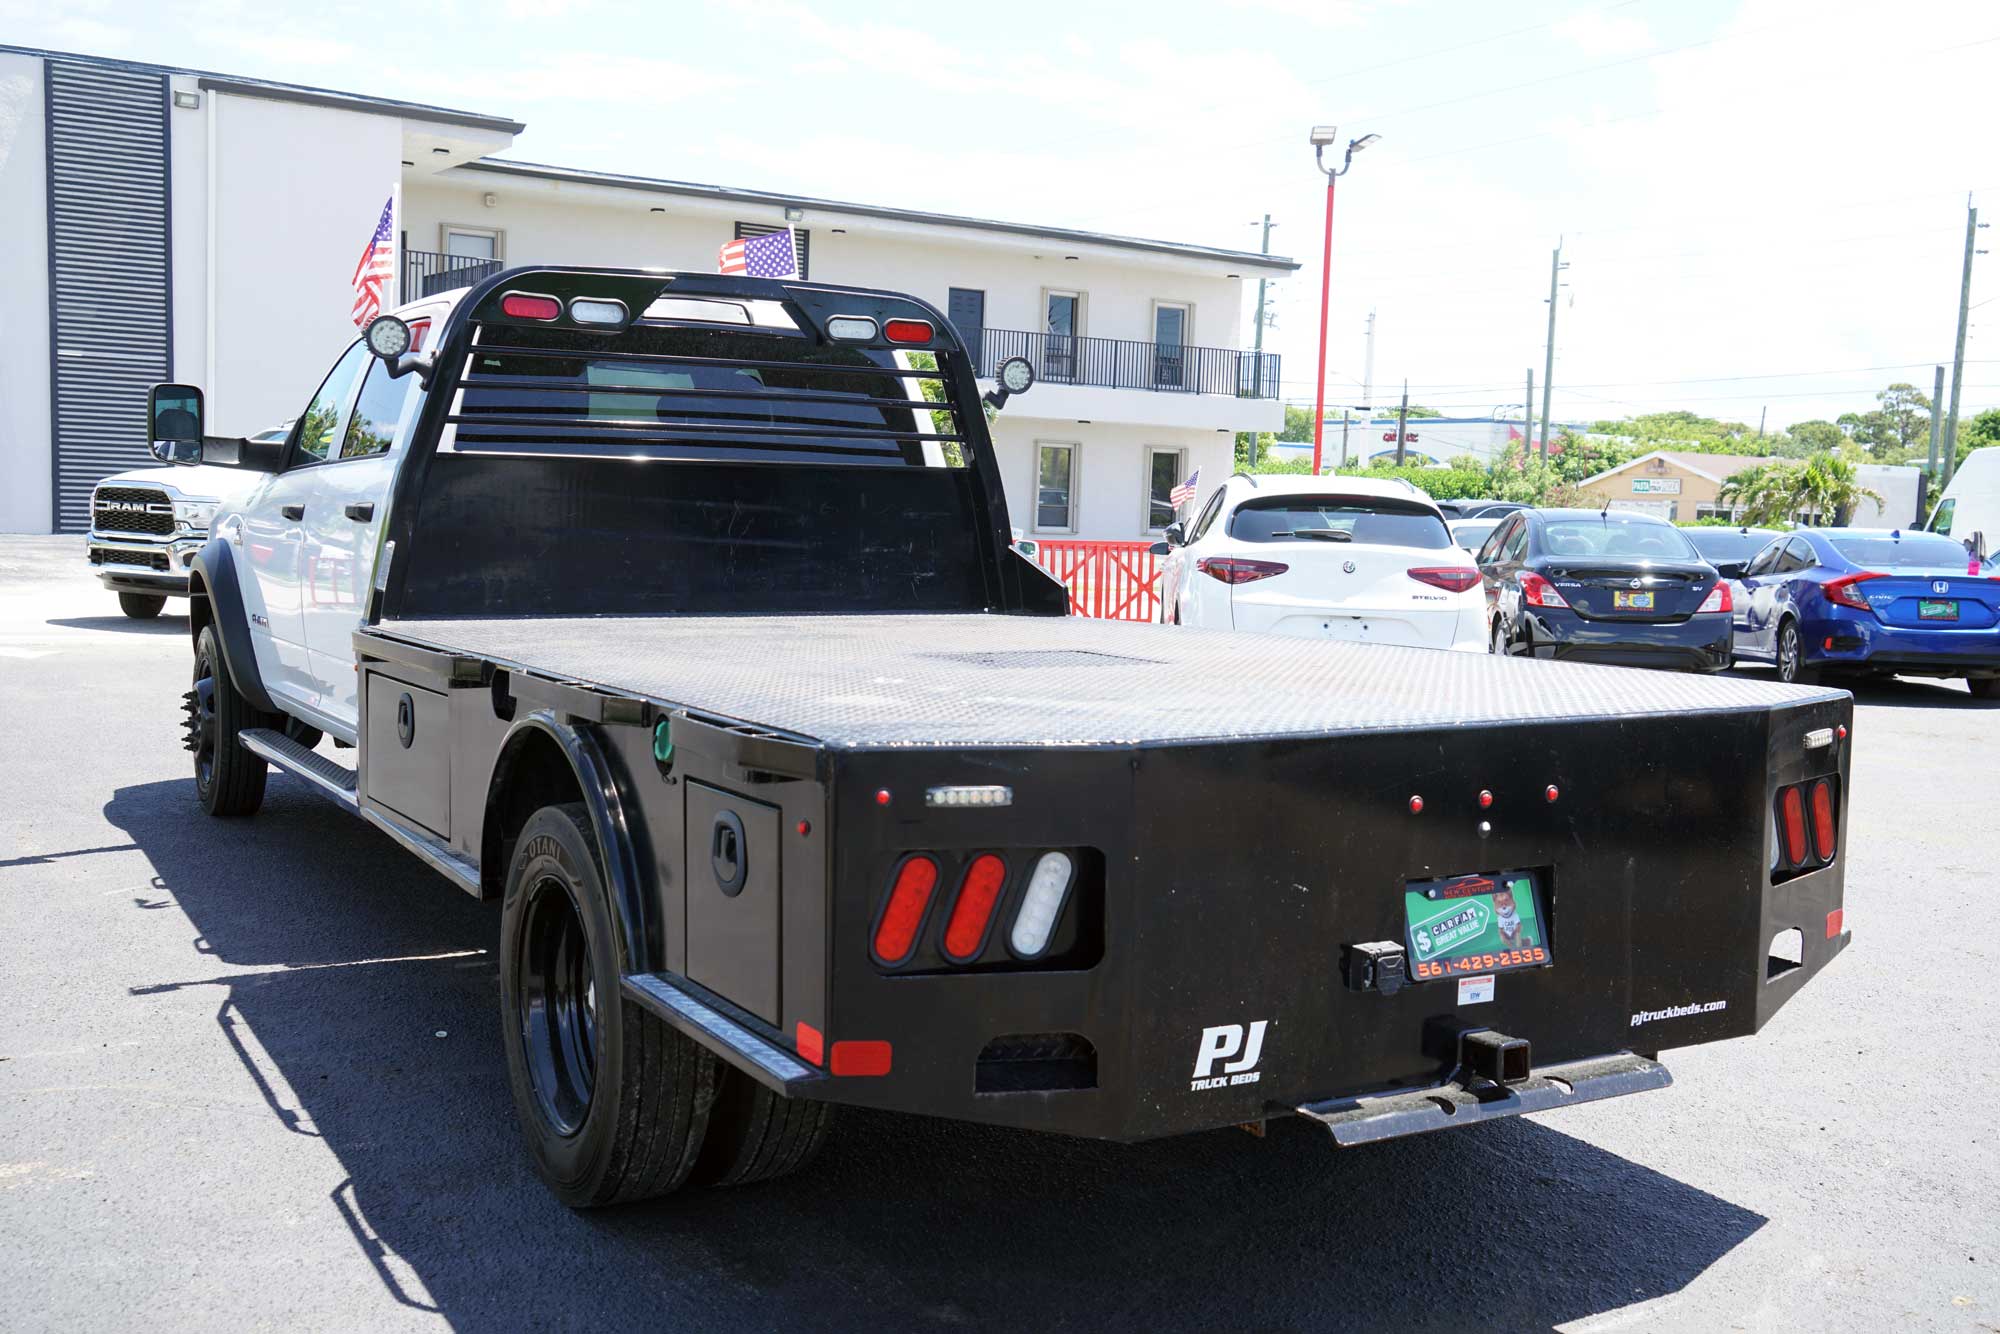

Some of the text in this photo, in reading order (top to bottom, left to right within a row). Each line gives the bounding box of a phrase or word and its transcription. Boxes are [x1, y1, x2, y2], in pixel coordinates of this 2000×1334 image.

[111, 502, 145, 512] RAM
[251, 613, 270, 629] RAM
[528, 836, 561, 861] OTANI
[1431, 907, 1478, 937] CARFAX
[1434, 921, 1480, 947] GREAT VALUE
[1416, 947, 1545, 978] 561-429-2535
[1630, 1000, 1727, 1027] pjtruckbeds.com
[1192, 1020, 1268, 1078] PJ
[1190, 1071, 1261, 1092] TRUCK BEDS
